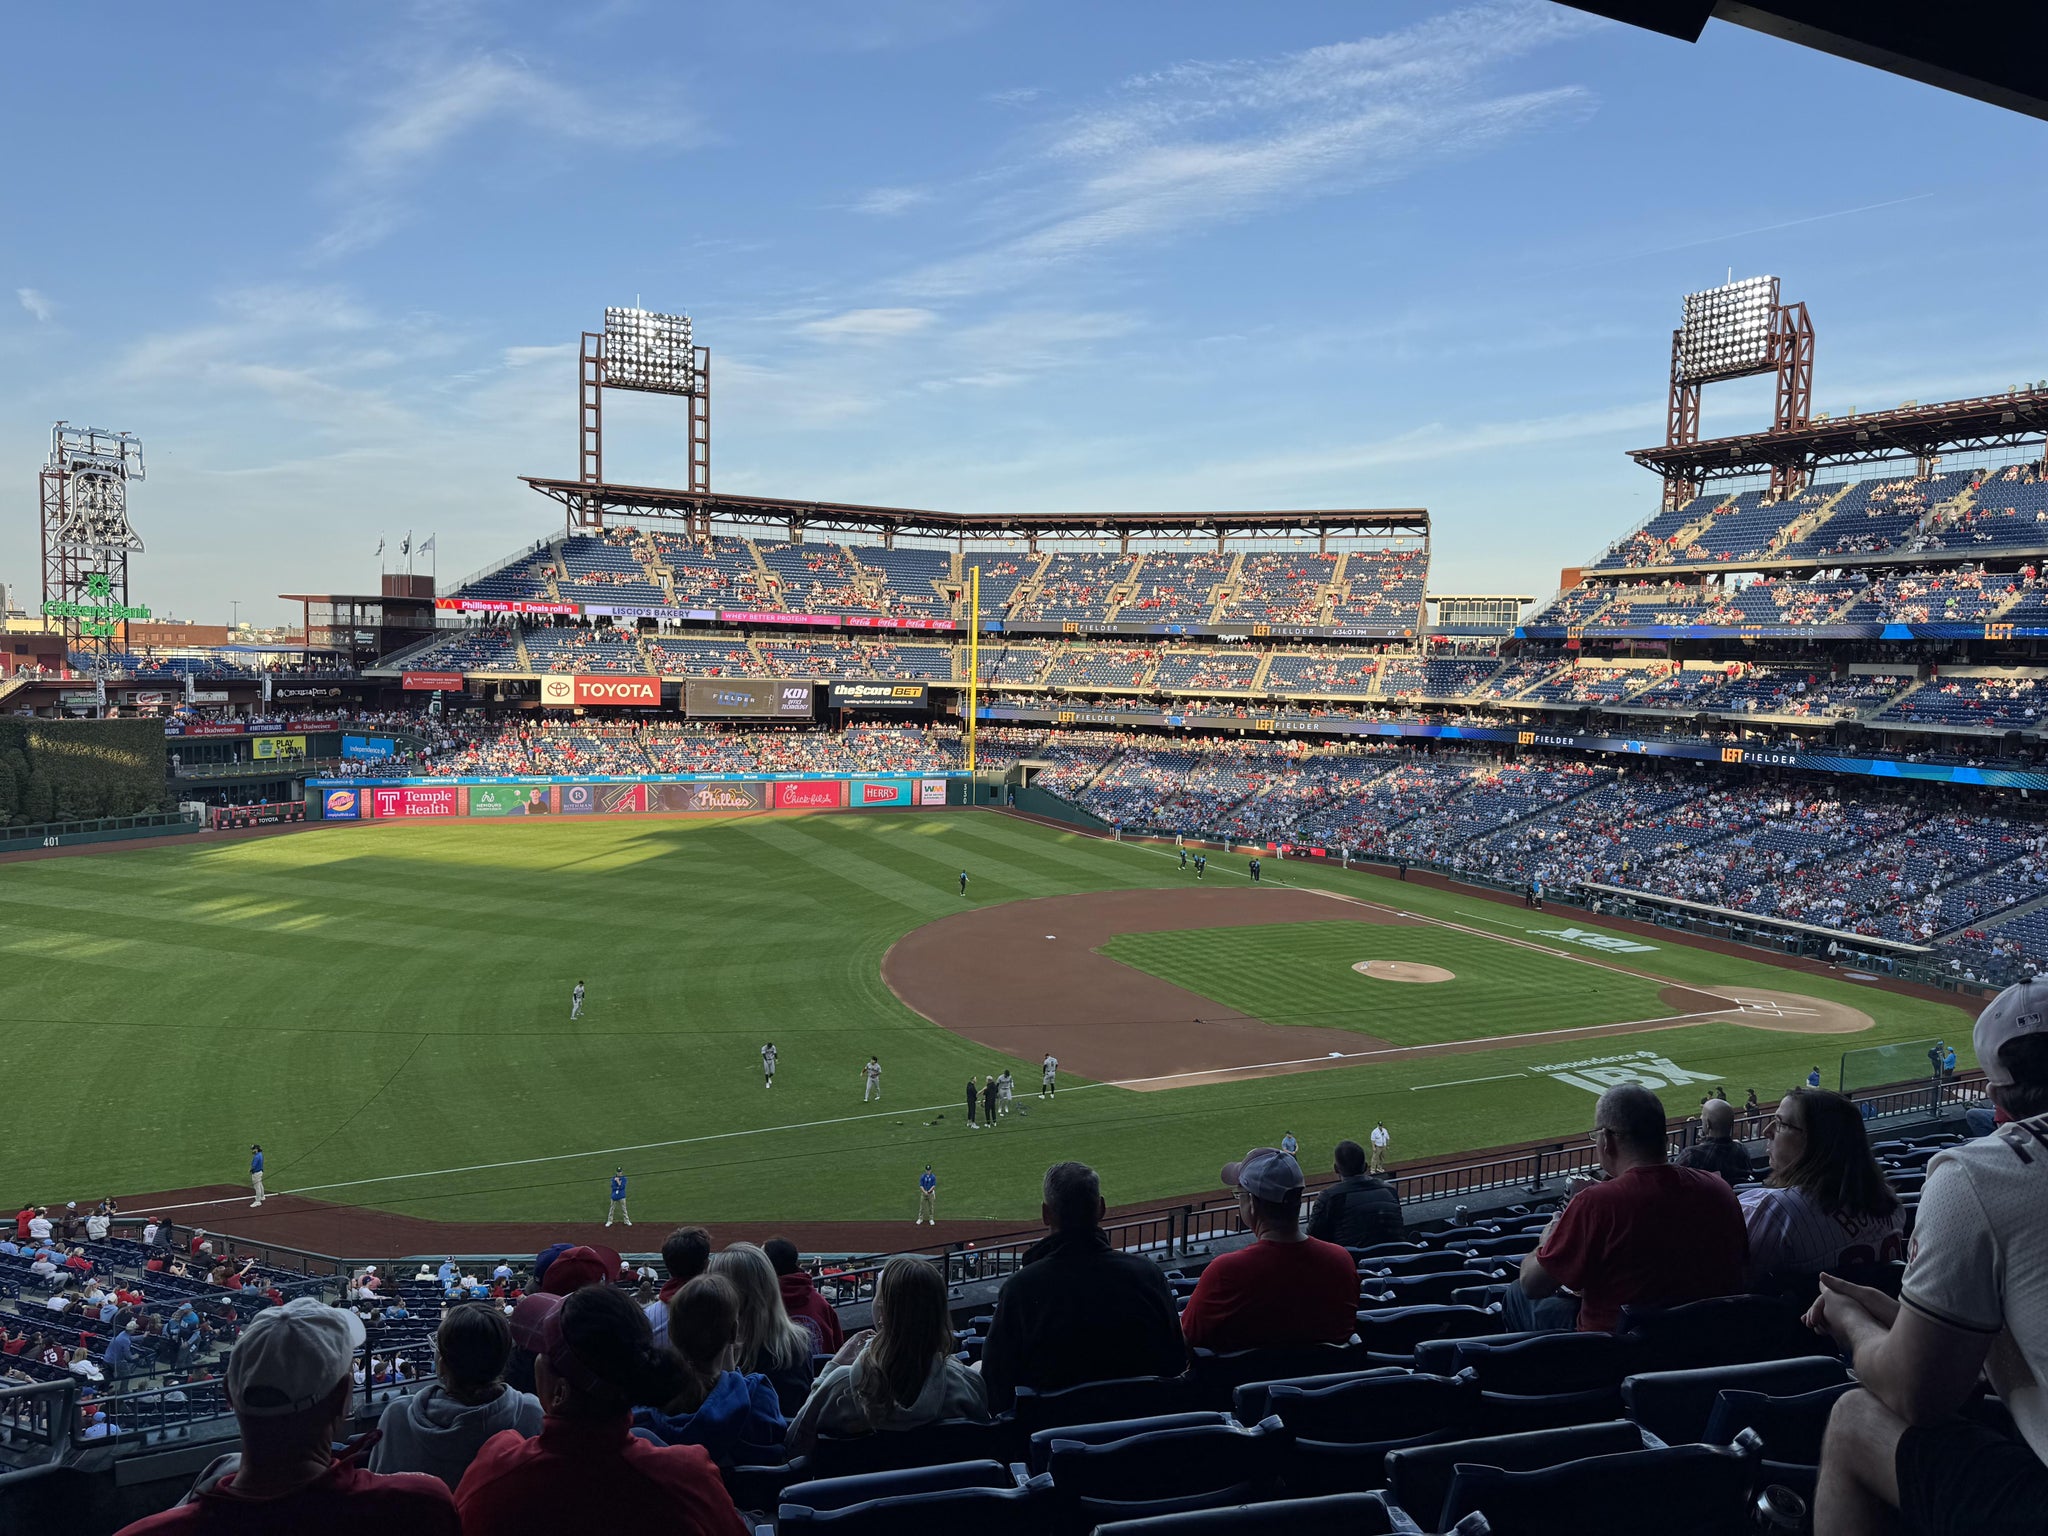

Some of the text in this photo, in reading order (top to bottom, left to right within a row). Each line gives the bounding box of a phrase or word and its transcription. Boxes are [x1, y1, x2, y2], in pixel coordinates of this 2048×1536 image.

[44, 600, 152, 618] Citizens Bank
[462, 602, 492, 610] Phillies
[526, 604, 548, 612] Deals
[612, 607, 690, 618] LISCIO'S BAKERY
[81, 620, 116, 636] Park
[1062, 622, 1079, 632] LEFT
[1253, 626, 1271, 636] LEFT
[1984, 624, 2014, 639] LEFT
[579, 683, 654, 698] TOYOTA
[834, 685, 892, 697] theScore
[712, 694, 755, 702] FIELDER
[1058, 712, 1075, 722] LEFT
[1256, 719, 1275, 730] LEFT
[1518, 731, 1574, 745] LEFT FIELDER
[350, 746, 381, 754] Independence
[1722, 748, 1795, 764] LEFT FIELDER
[404, 790, 452, 804] Temple
[866, 787, 894, 799] HERR'S
[699, 790, 750, 808] Phillies
[406, 804, 450, 815] Health
[43, 836, 59, 846] 401
[1528, 1053, 1639, 1072] Independence
